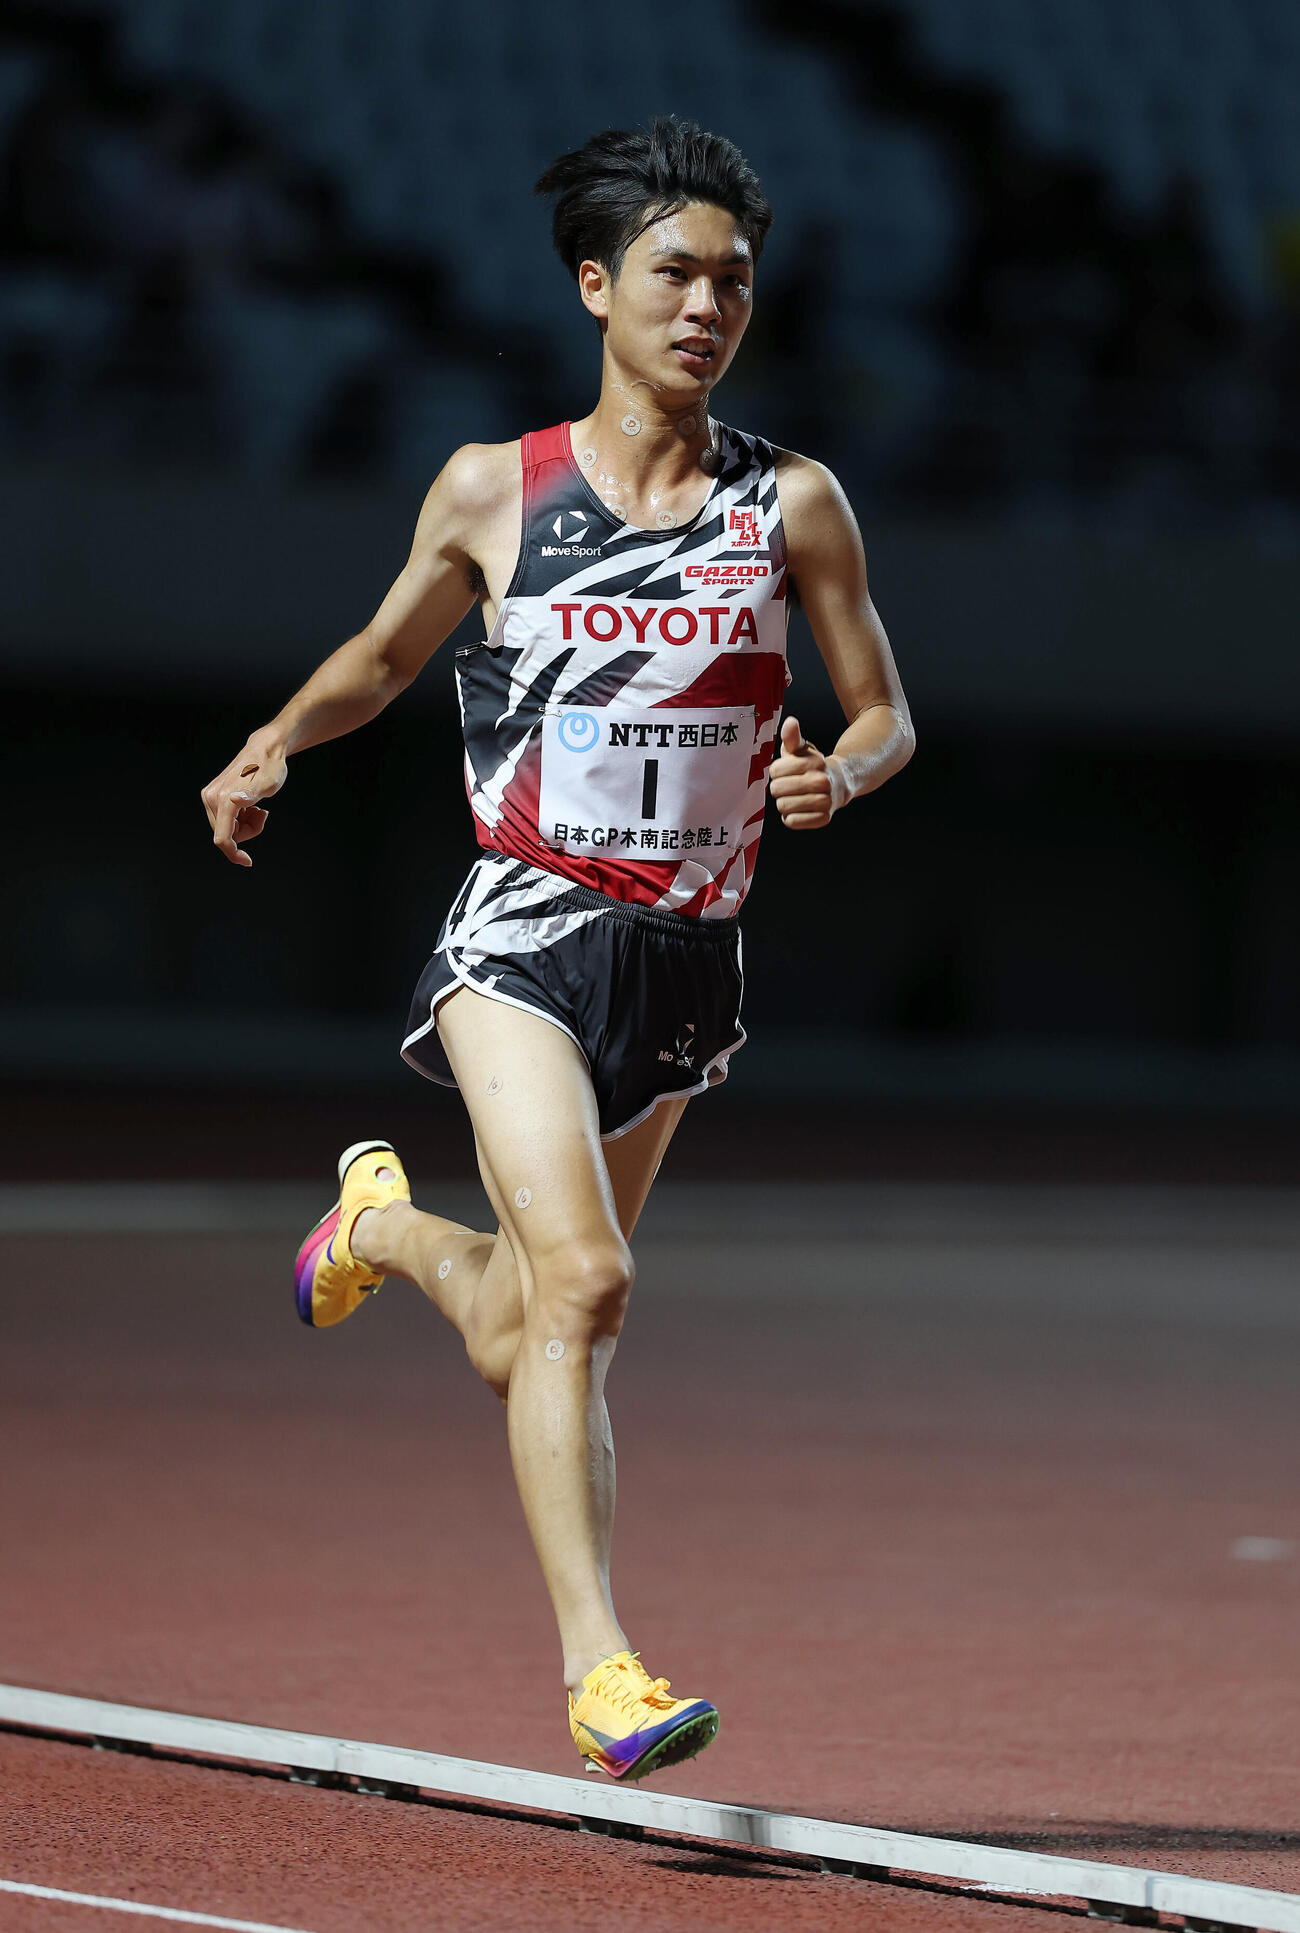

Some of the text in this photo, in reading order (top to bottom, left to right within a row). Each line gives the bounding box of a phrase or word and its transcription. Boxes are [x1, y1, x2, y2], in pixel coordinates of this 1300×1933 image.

[541, 545, 602, 558] MoveSport
[685, 565, 769, 578] GAZOO
[701, 577, 755, 585] SPORTS
[551, 603, 759, 646] TOYOTA
[609, 722, 739, 748] NTT 西日本
[554, 823, 729, 850] 日本GP木南記念陸上
